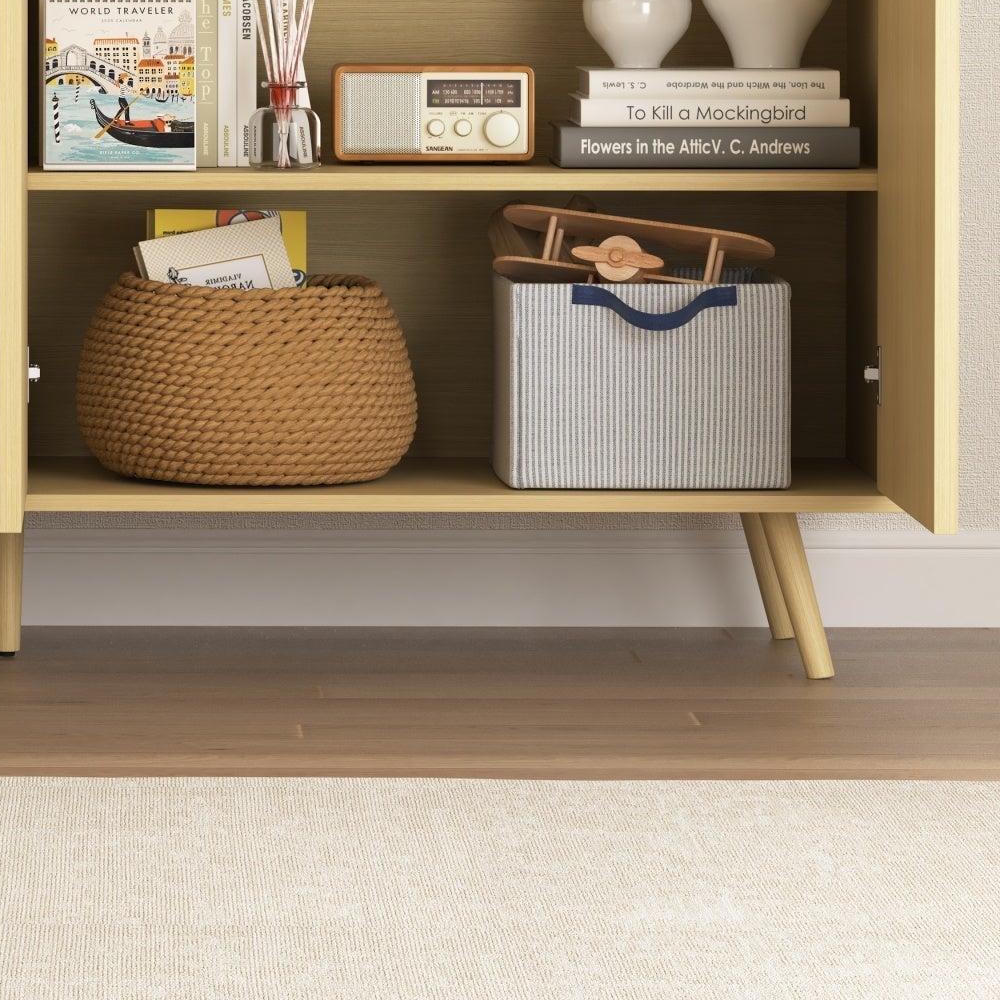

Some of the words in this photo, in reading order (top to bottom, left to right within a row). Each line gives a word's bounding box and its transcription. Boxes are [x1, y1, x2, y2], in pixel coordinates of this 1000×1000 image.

[117, 7, 173, 15] TRAVELER
[602, 81, 625, 89] Lewis
[666, 81, 708, 89] Wardrobe
[710, 81, 725, 89] the
[727, 81, 744, 89] and
[746, 81, 770, 89] Witch
[772, 81, 786, 89] the
[788, 81, 808, 89] Lion,
[810, 81, 825, 89] The
[626, 105, 646, 120] To
[652, 105, 673, 120] Kill
[679, 109, 690, 120] a
[696, 105, 806, 124] Mockingbird
[581, 139, 632, 154] Flowers
[636, 139, 648, 154] in
[652, 139, 675, 154] the
[729, 139, 745, 154] C.
[749, 139, 810, 154] Andrews
